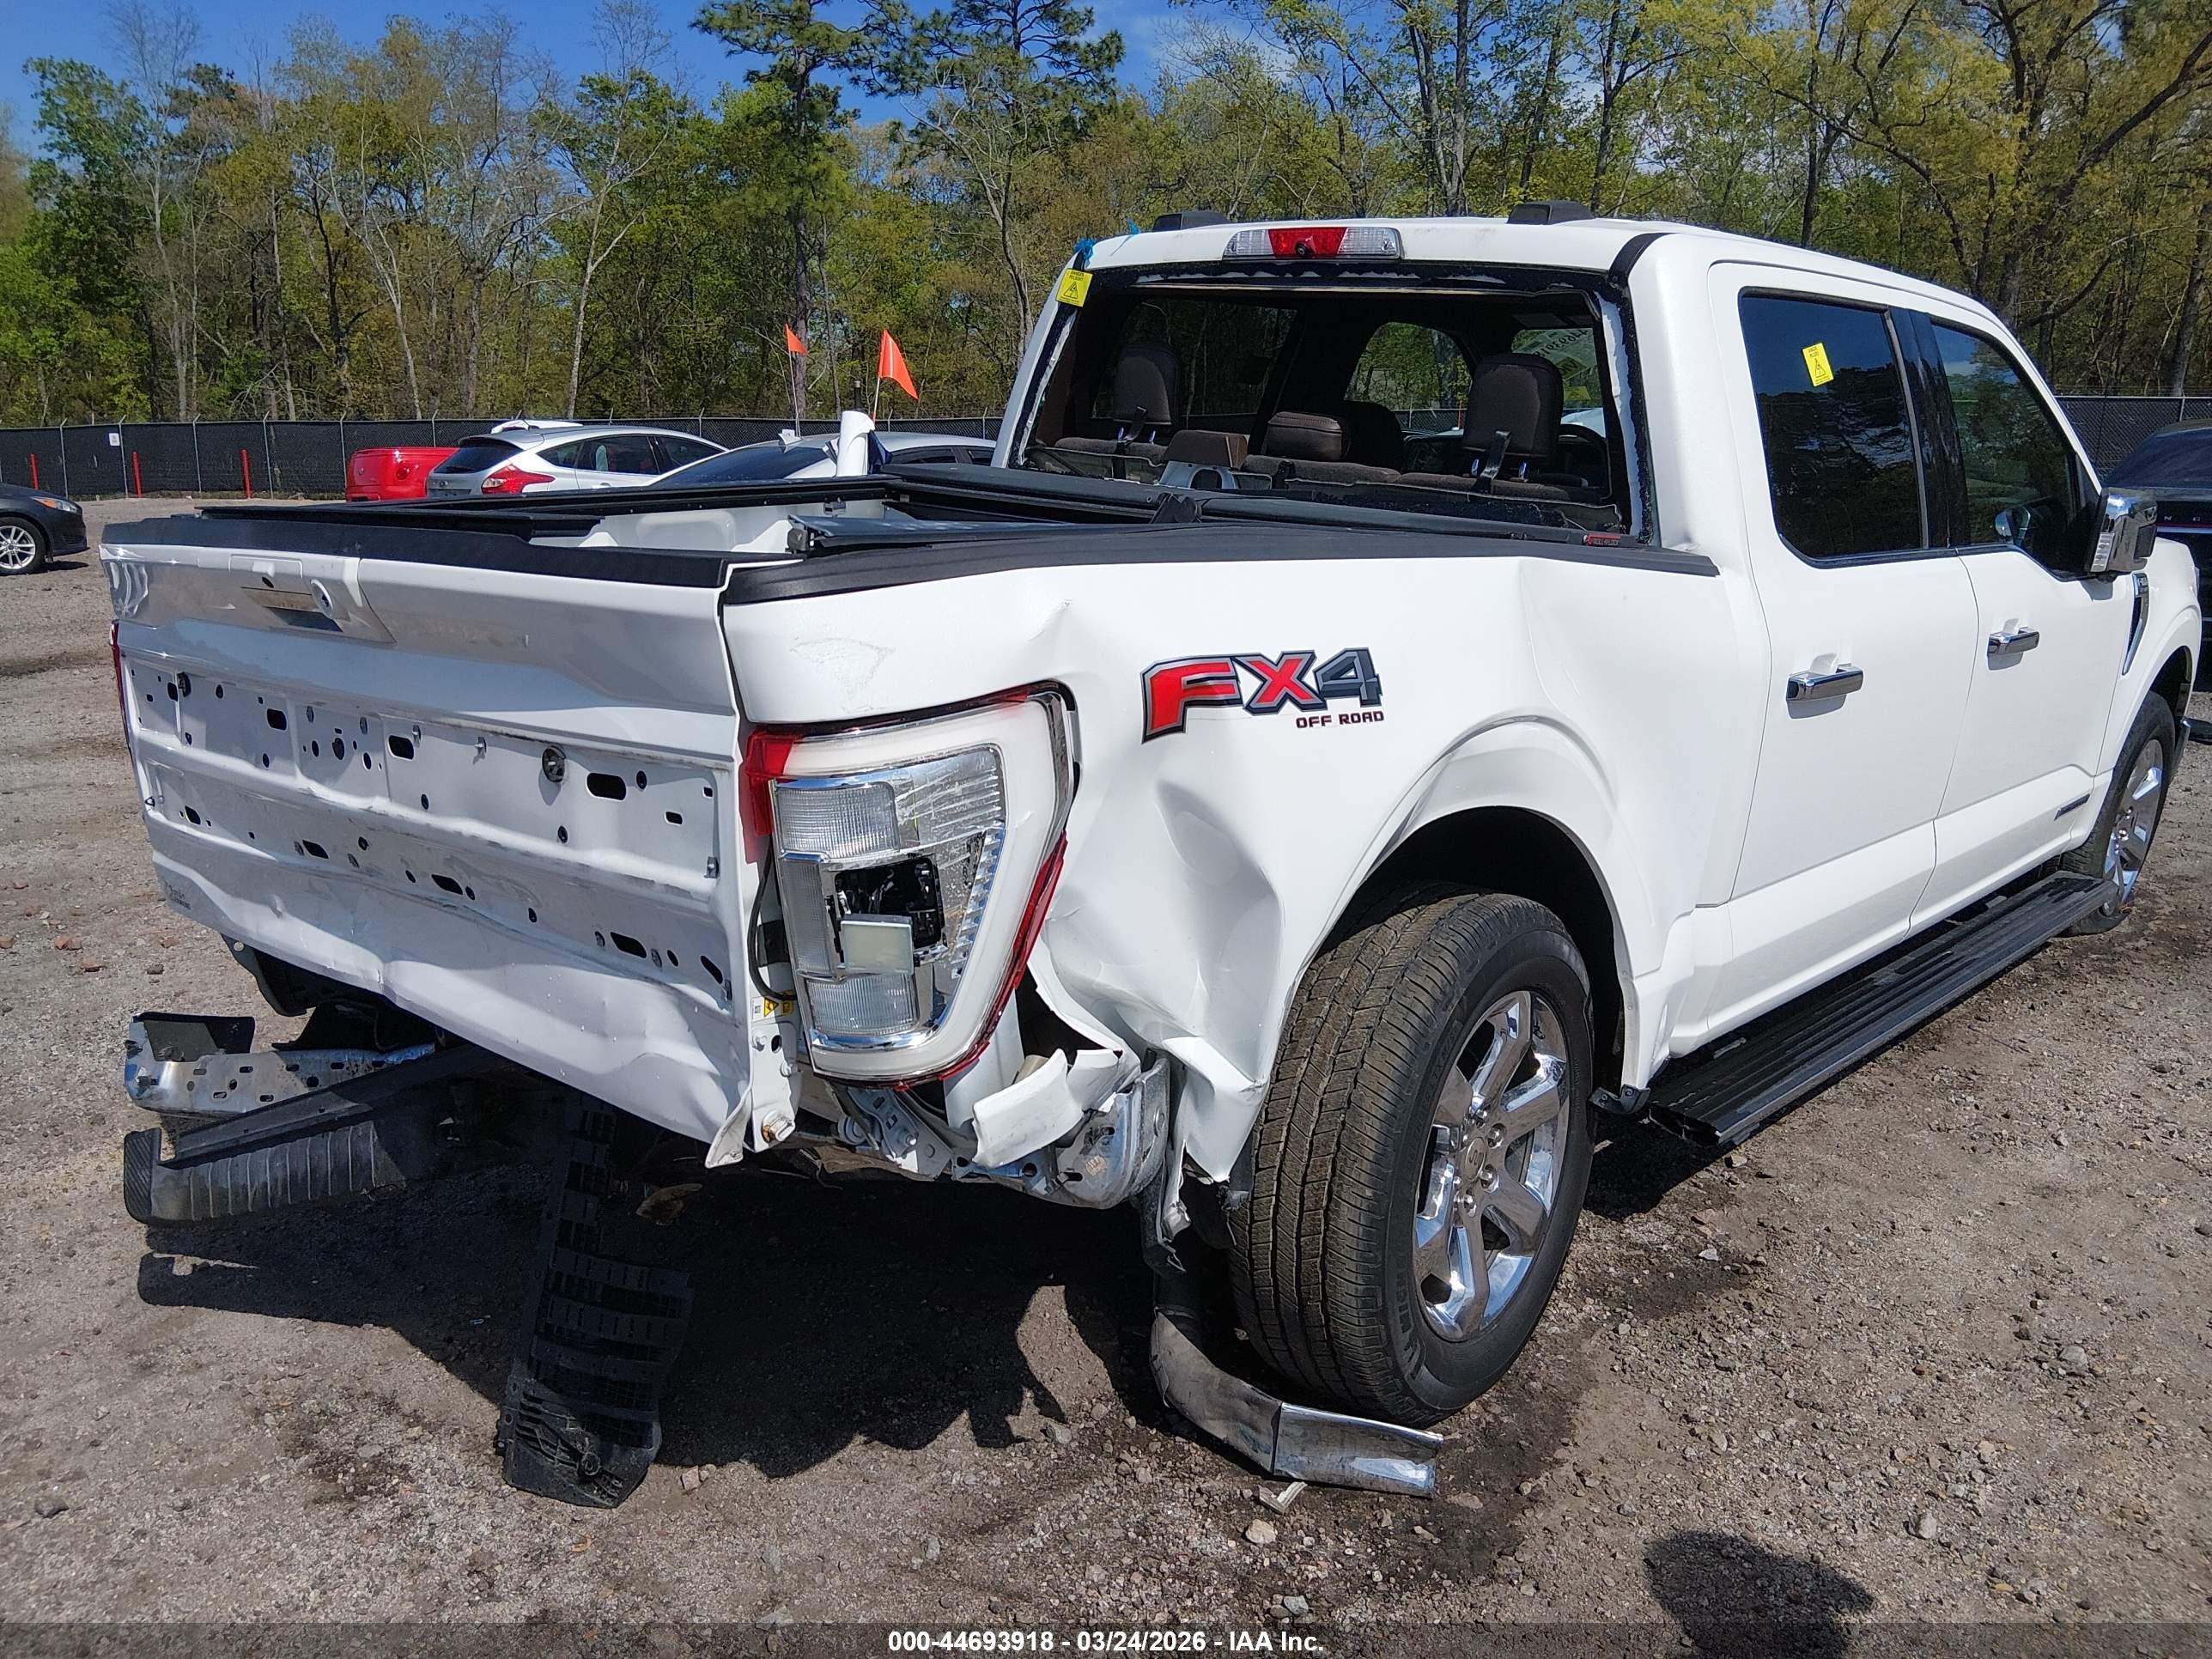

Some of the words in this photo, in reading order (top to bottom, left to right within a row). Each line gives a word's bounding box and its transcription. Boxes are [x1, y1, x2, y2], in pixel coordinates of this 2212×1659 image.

[1140, 647, 1383, 744] FX4
[1296, 714, 1332, 728] OFF
[1339, 710, 1384, 725] ROAD
